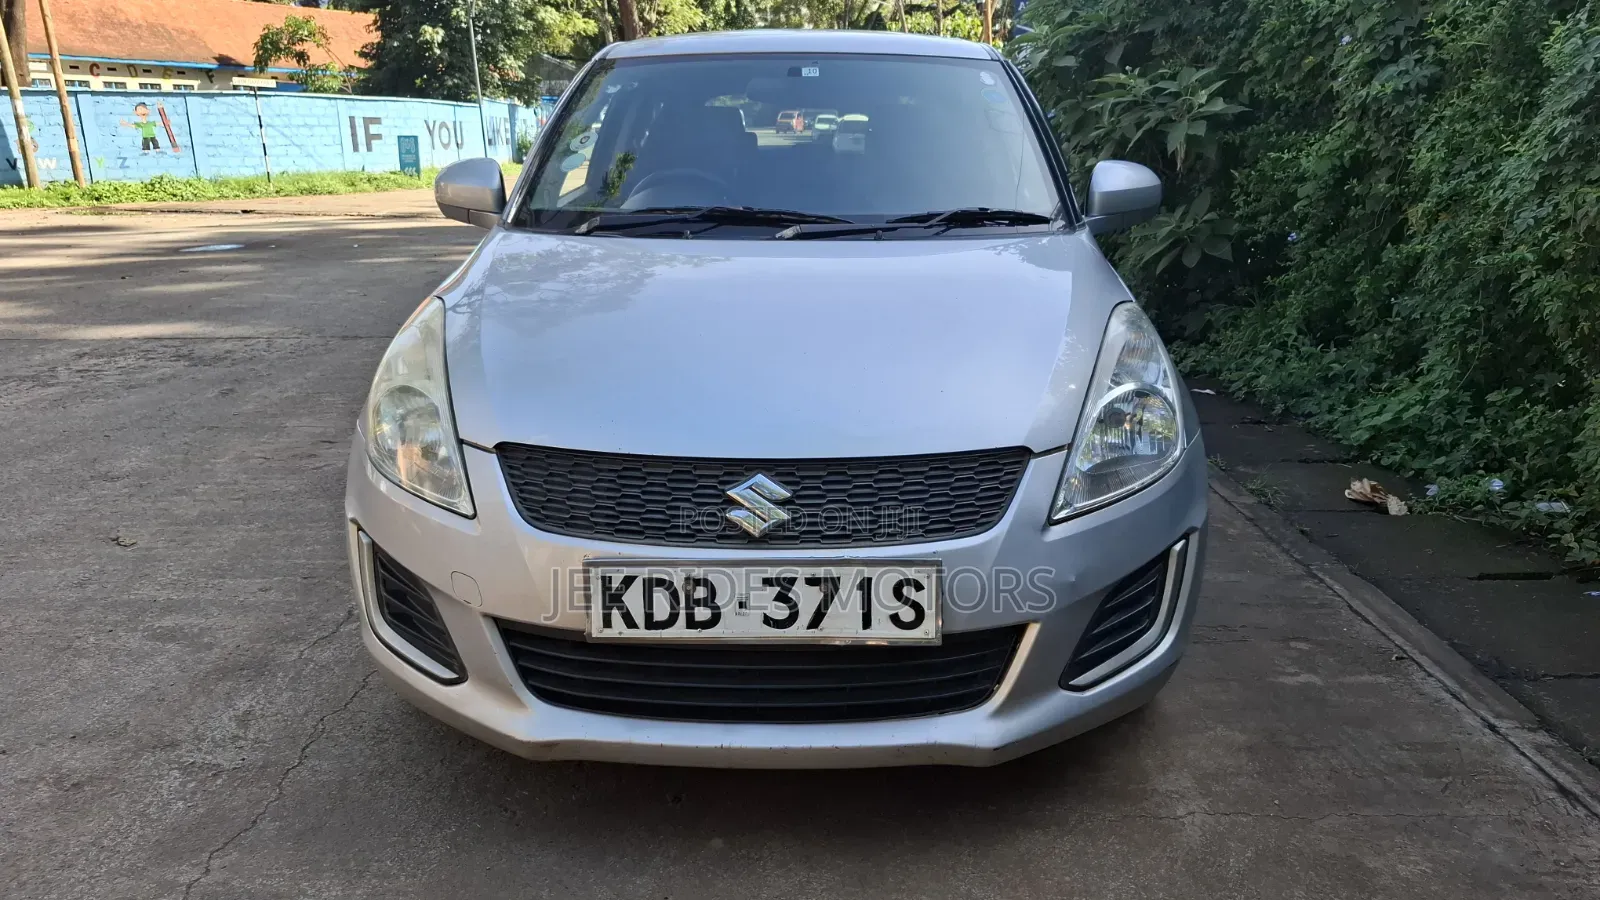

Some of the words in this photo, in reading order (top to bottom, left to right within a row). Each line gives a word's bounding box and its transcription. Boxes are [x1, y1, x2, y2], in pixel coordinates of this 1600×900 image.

[89, 63, 100, 77] C
[126, 64, 138, 78] D
[206, 70, 214, 83] F
[348, 116, 383, 152] IF
[424, 119, 464, 150] YOU
[485, 116, 510, 146] LIKE
[6, 158, 17, 170] V
[37, 157, 57, 169] W
[94, 156, 105, 168] Y
[117, 157, 130, 168] Z
[601, 575, 722, 631] KDB
[761, 576, 926, 631] 371S
